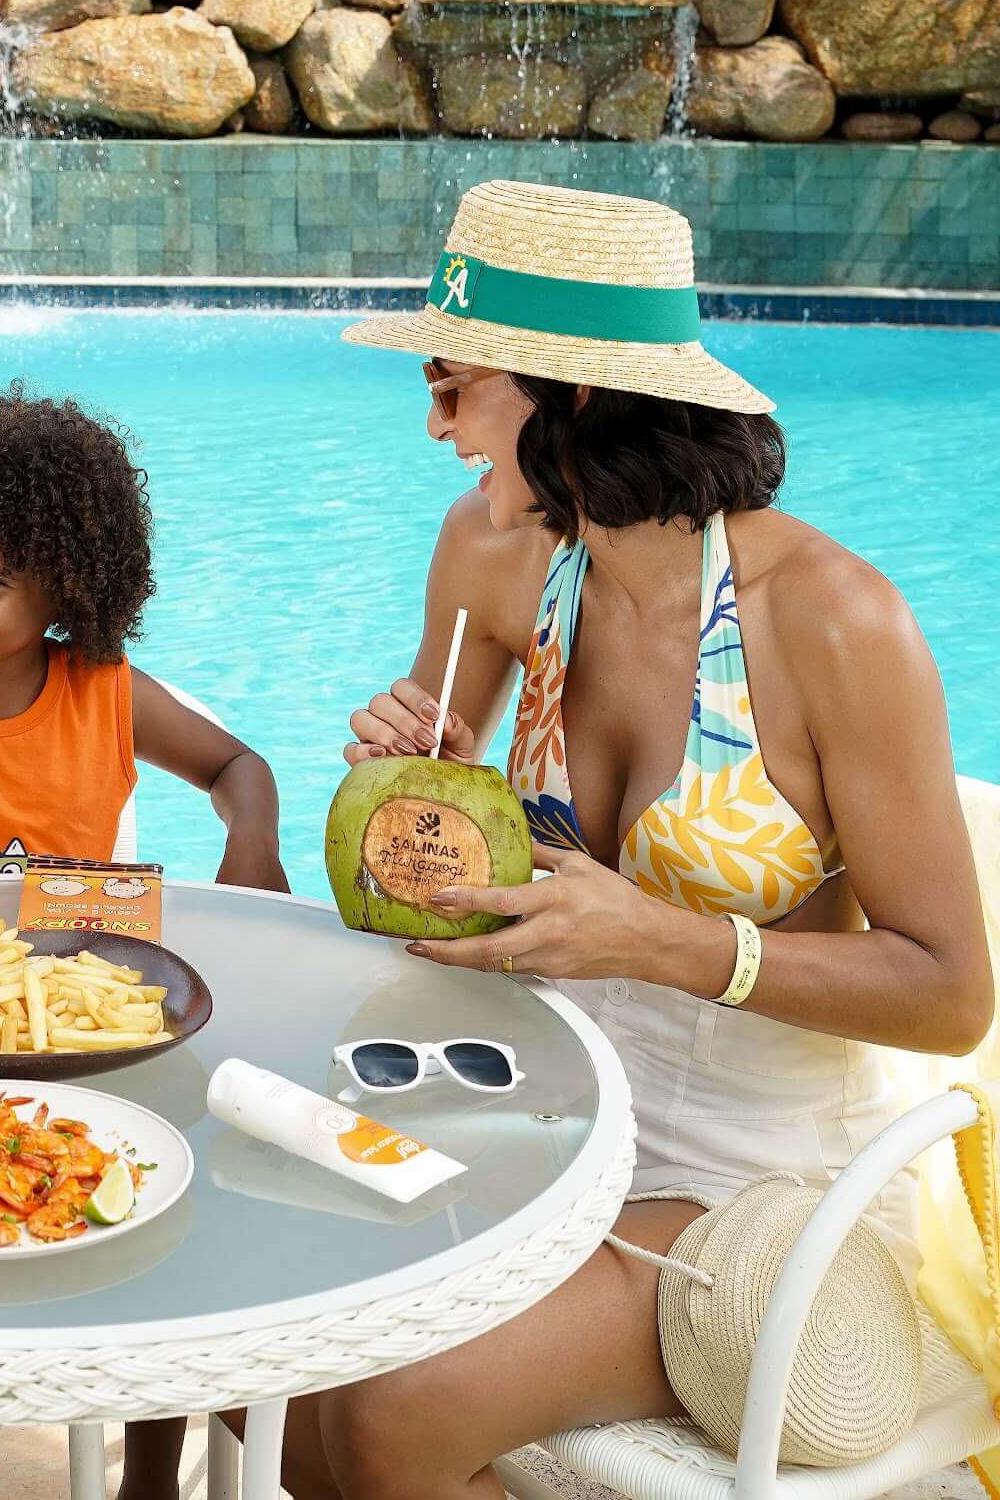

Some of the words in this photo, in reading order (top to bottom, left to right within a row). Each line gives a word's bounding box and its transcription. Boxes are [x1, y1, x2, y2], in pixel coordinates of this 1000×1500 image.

[391, 836, 460, 859] SALINAS
[380, 850, 467, 881] Maragogi
[91, 903, 141, 911] CHARLIE
[23, 918, 154, 932] SNOOPY
